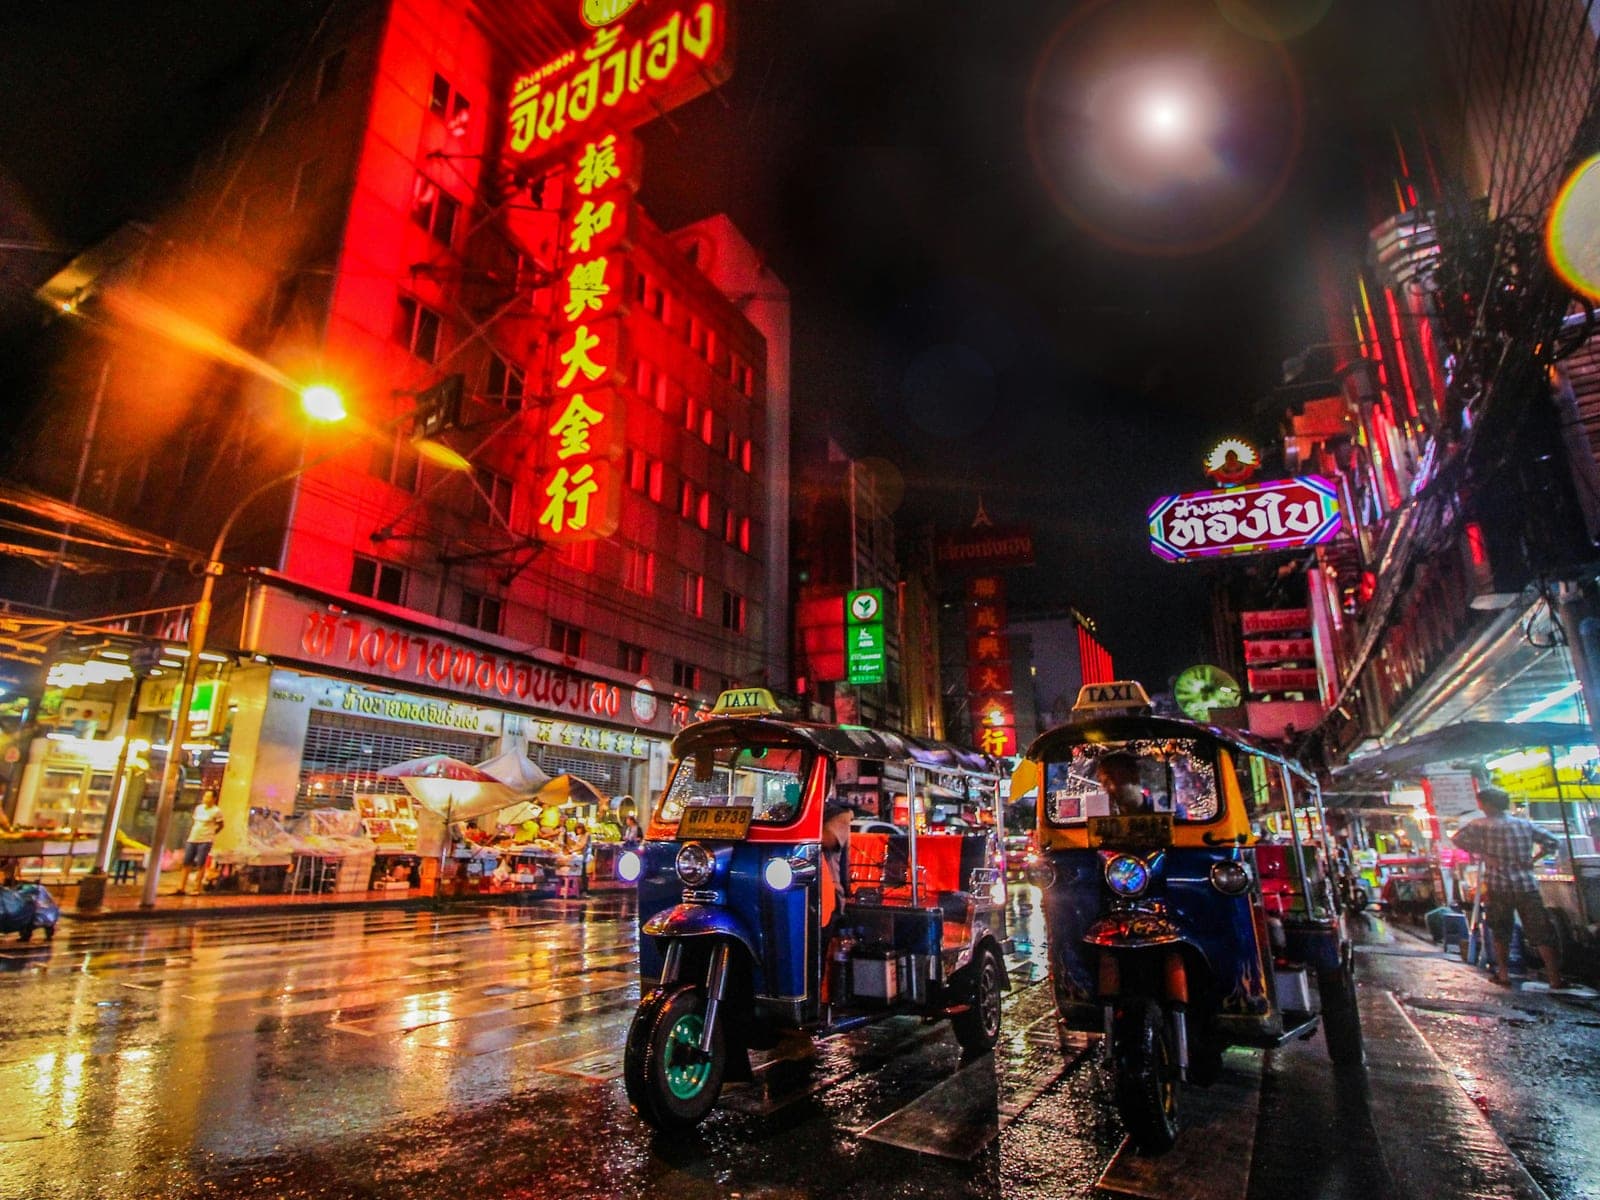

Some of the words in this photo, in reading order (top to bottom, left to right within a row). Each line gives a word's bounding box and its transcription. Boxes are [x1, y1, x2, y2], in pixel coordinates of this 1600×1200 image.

[539, 134, 621, 533] 振和興大金行
[724, 692, 760, 708] TAXI
[1087, 684, 1133, 702] TAXI
